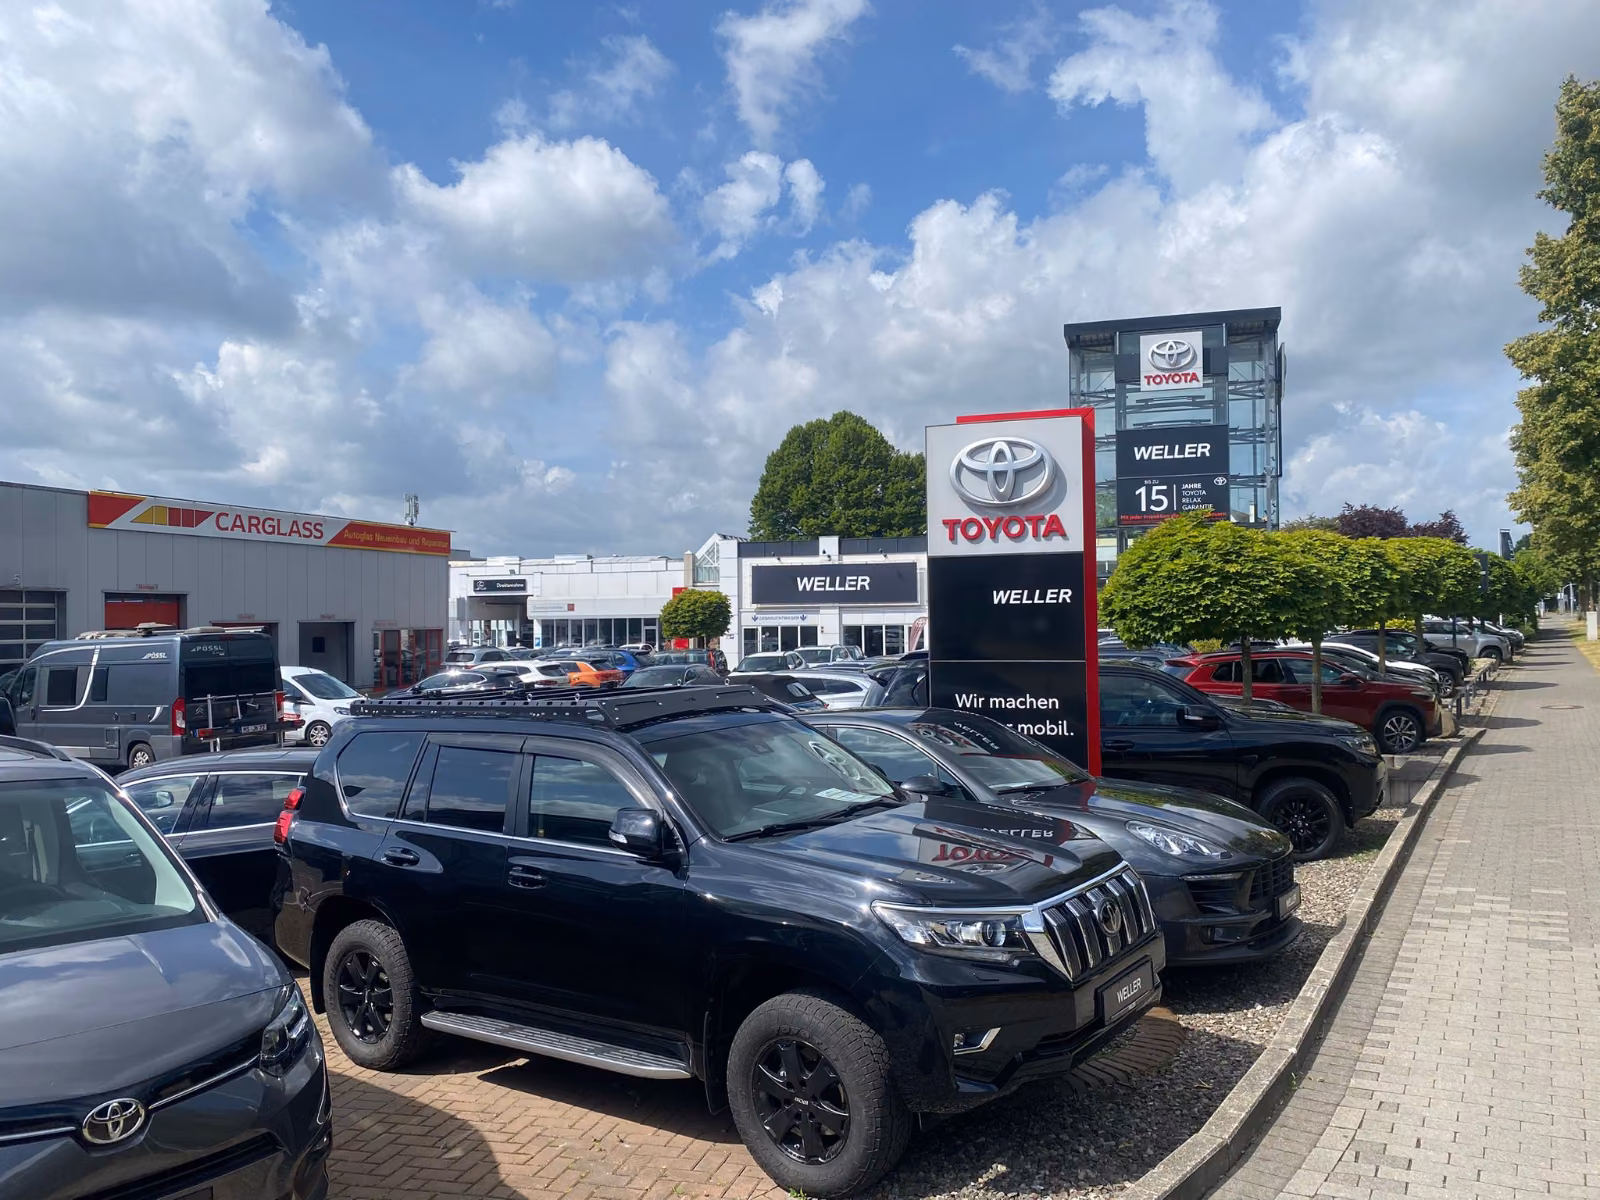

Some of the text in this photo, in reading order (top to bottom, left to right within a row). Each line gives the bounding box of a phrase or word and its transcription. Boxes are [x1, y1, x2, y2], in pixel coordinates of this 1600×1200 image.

[1144, 371, 1200, 386] TOYOTA
[1134, 443, 1211, 460] WELLER
[1135, 485, 1168, 512] 15
[215, 512, 324, 540] CARGLASS
[942, 514, 1067, 541] TOYOTA
[344, 530, 374, 542] Autoglas
[408, 537, 420, 546] und
[13, 574, 21, 585] 5
[797, 576, 870, 592] WELLER
[992, 588, 1072, 604] WELLER
[955, 694, 1059, 709] Wir machen
[1018, 720, 1074, 736] mobil.
[1116, 977, 1142, 1004] WELLER
